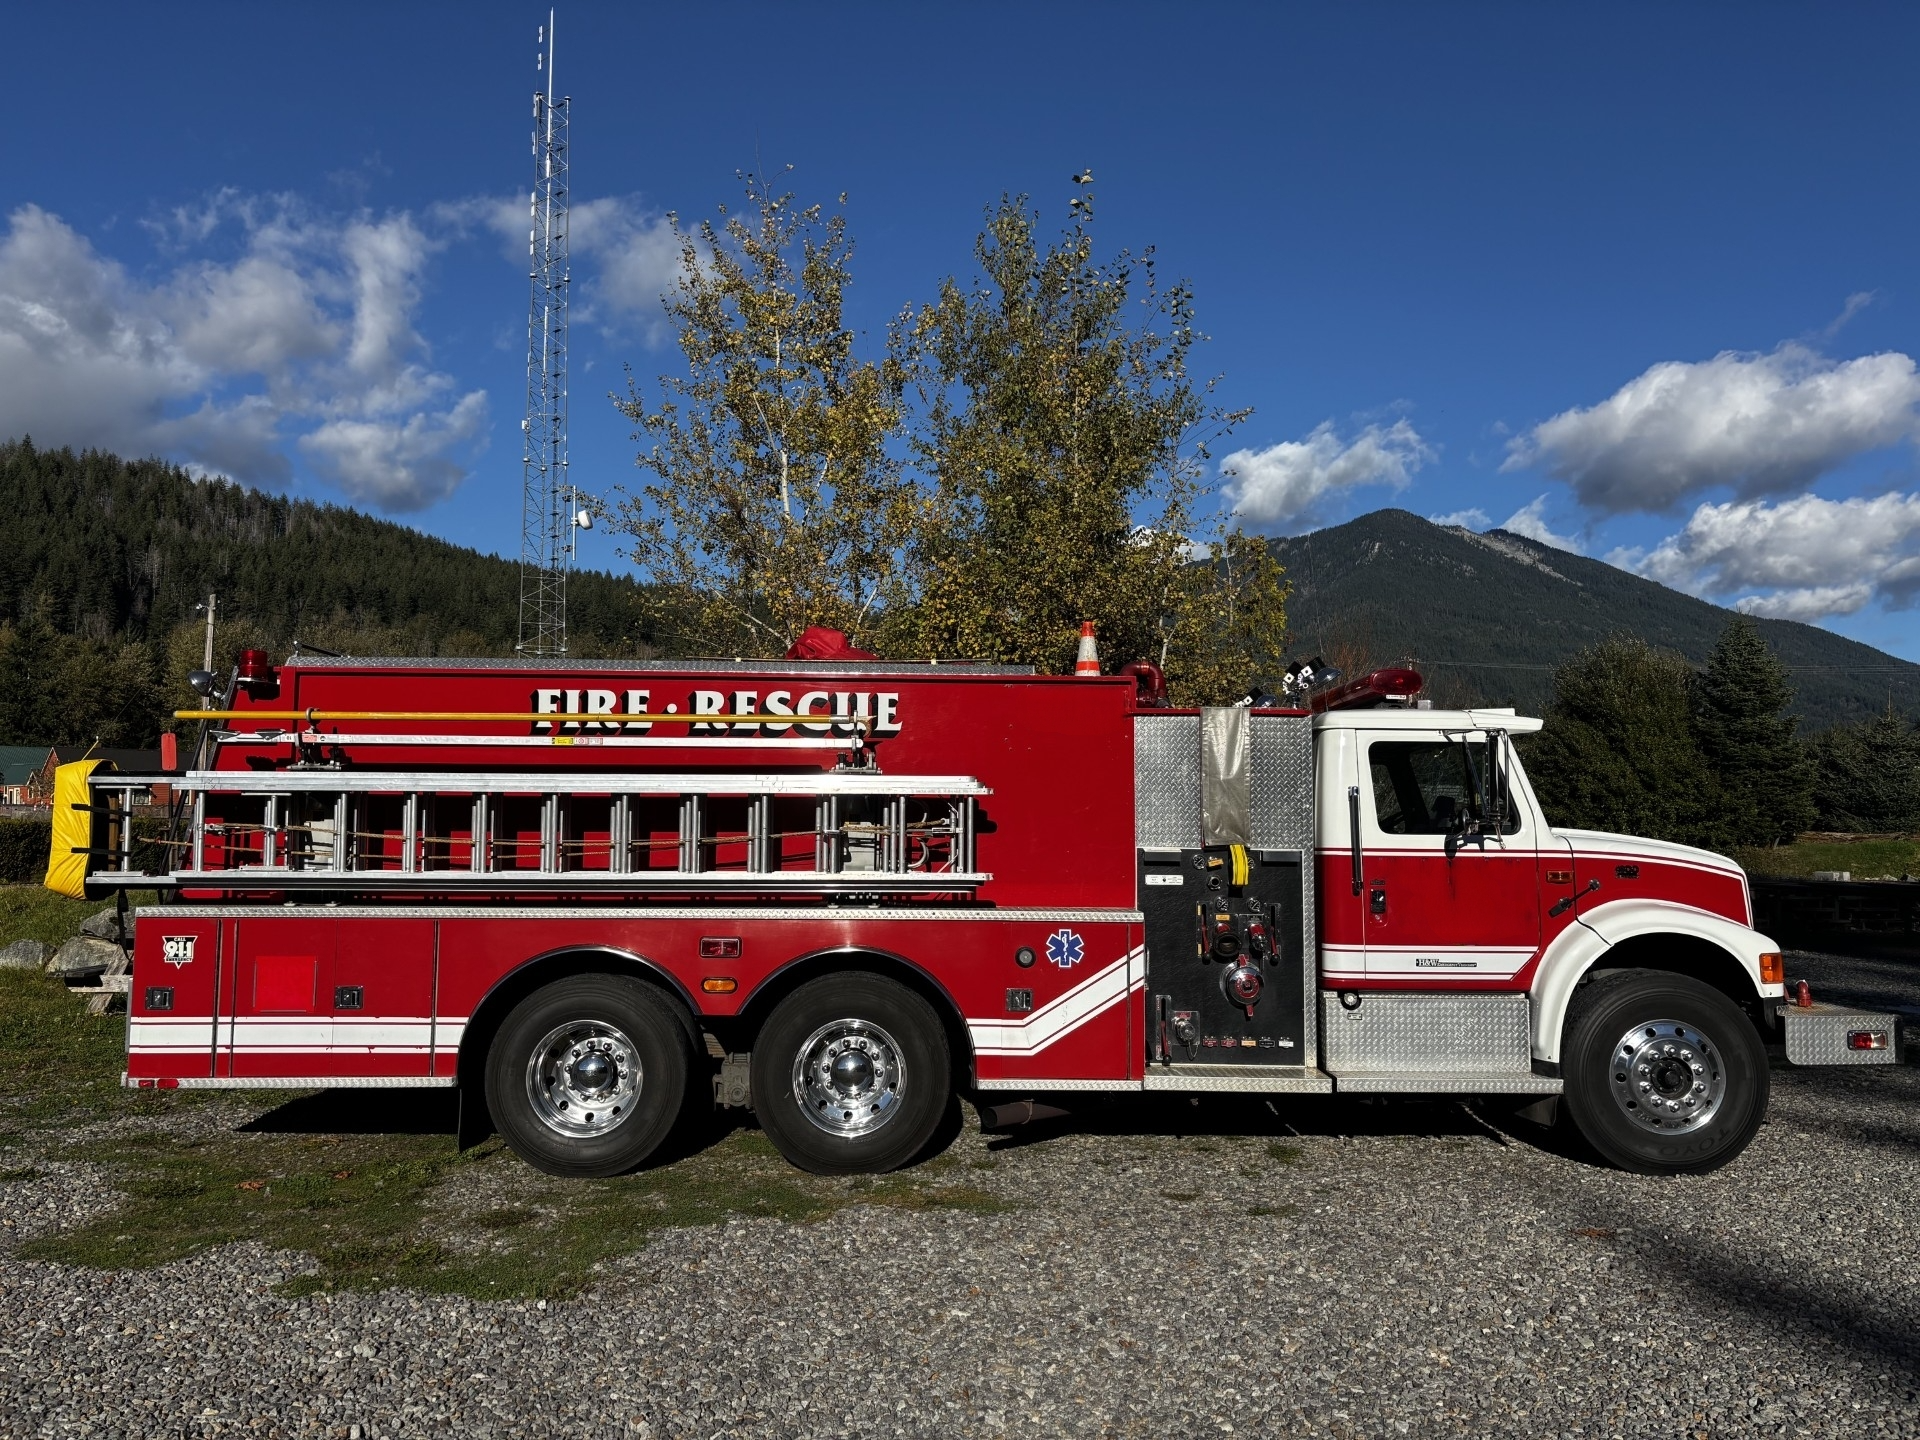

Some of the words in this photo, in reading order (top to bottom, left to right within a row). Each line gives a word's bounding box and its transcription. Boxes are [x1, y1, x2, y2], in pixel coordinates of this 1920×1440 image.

[532, 688, 653, 732] FIRE
[689, 690, 903, 734] RESCUE
[1419, 959, 1440, 967] H&W
[1659, 1128, 1730, 1156] TOYO
